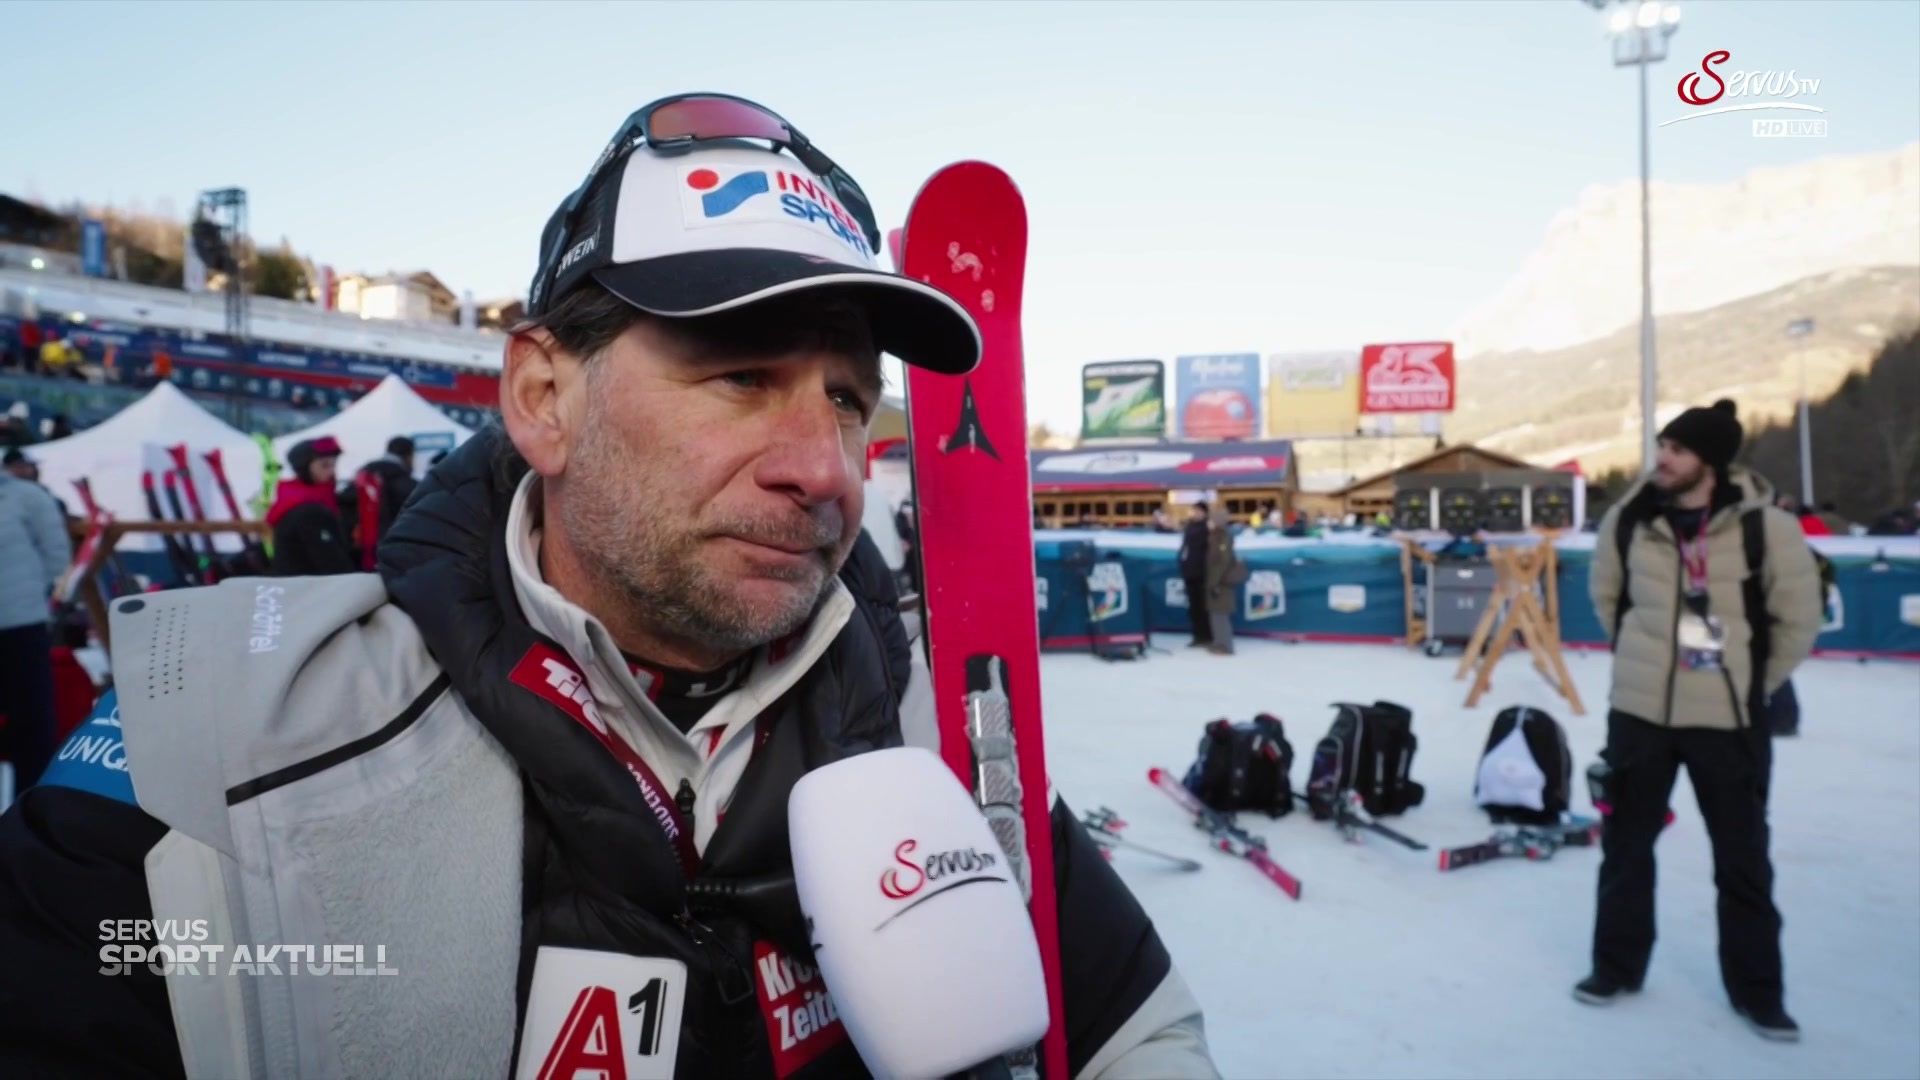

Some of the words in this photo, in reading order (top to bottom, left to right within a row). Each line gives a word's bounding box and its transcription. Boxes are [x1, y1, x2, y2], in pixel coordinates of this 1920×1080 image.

[776, 170, 860, 234] INTER
[781, 193, 869, 260] SPORT
[541, 657, 609, 736] Tiro
[58, 735, 129, 773] UNIQ
[535, 976, 669, 1080] A1
